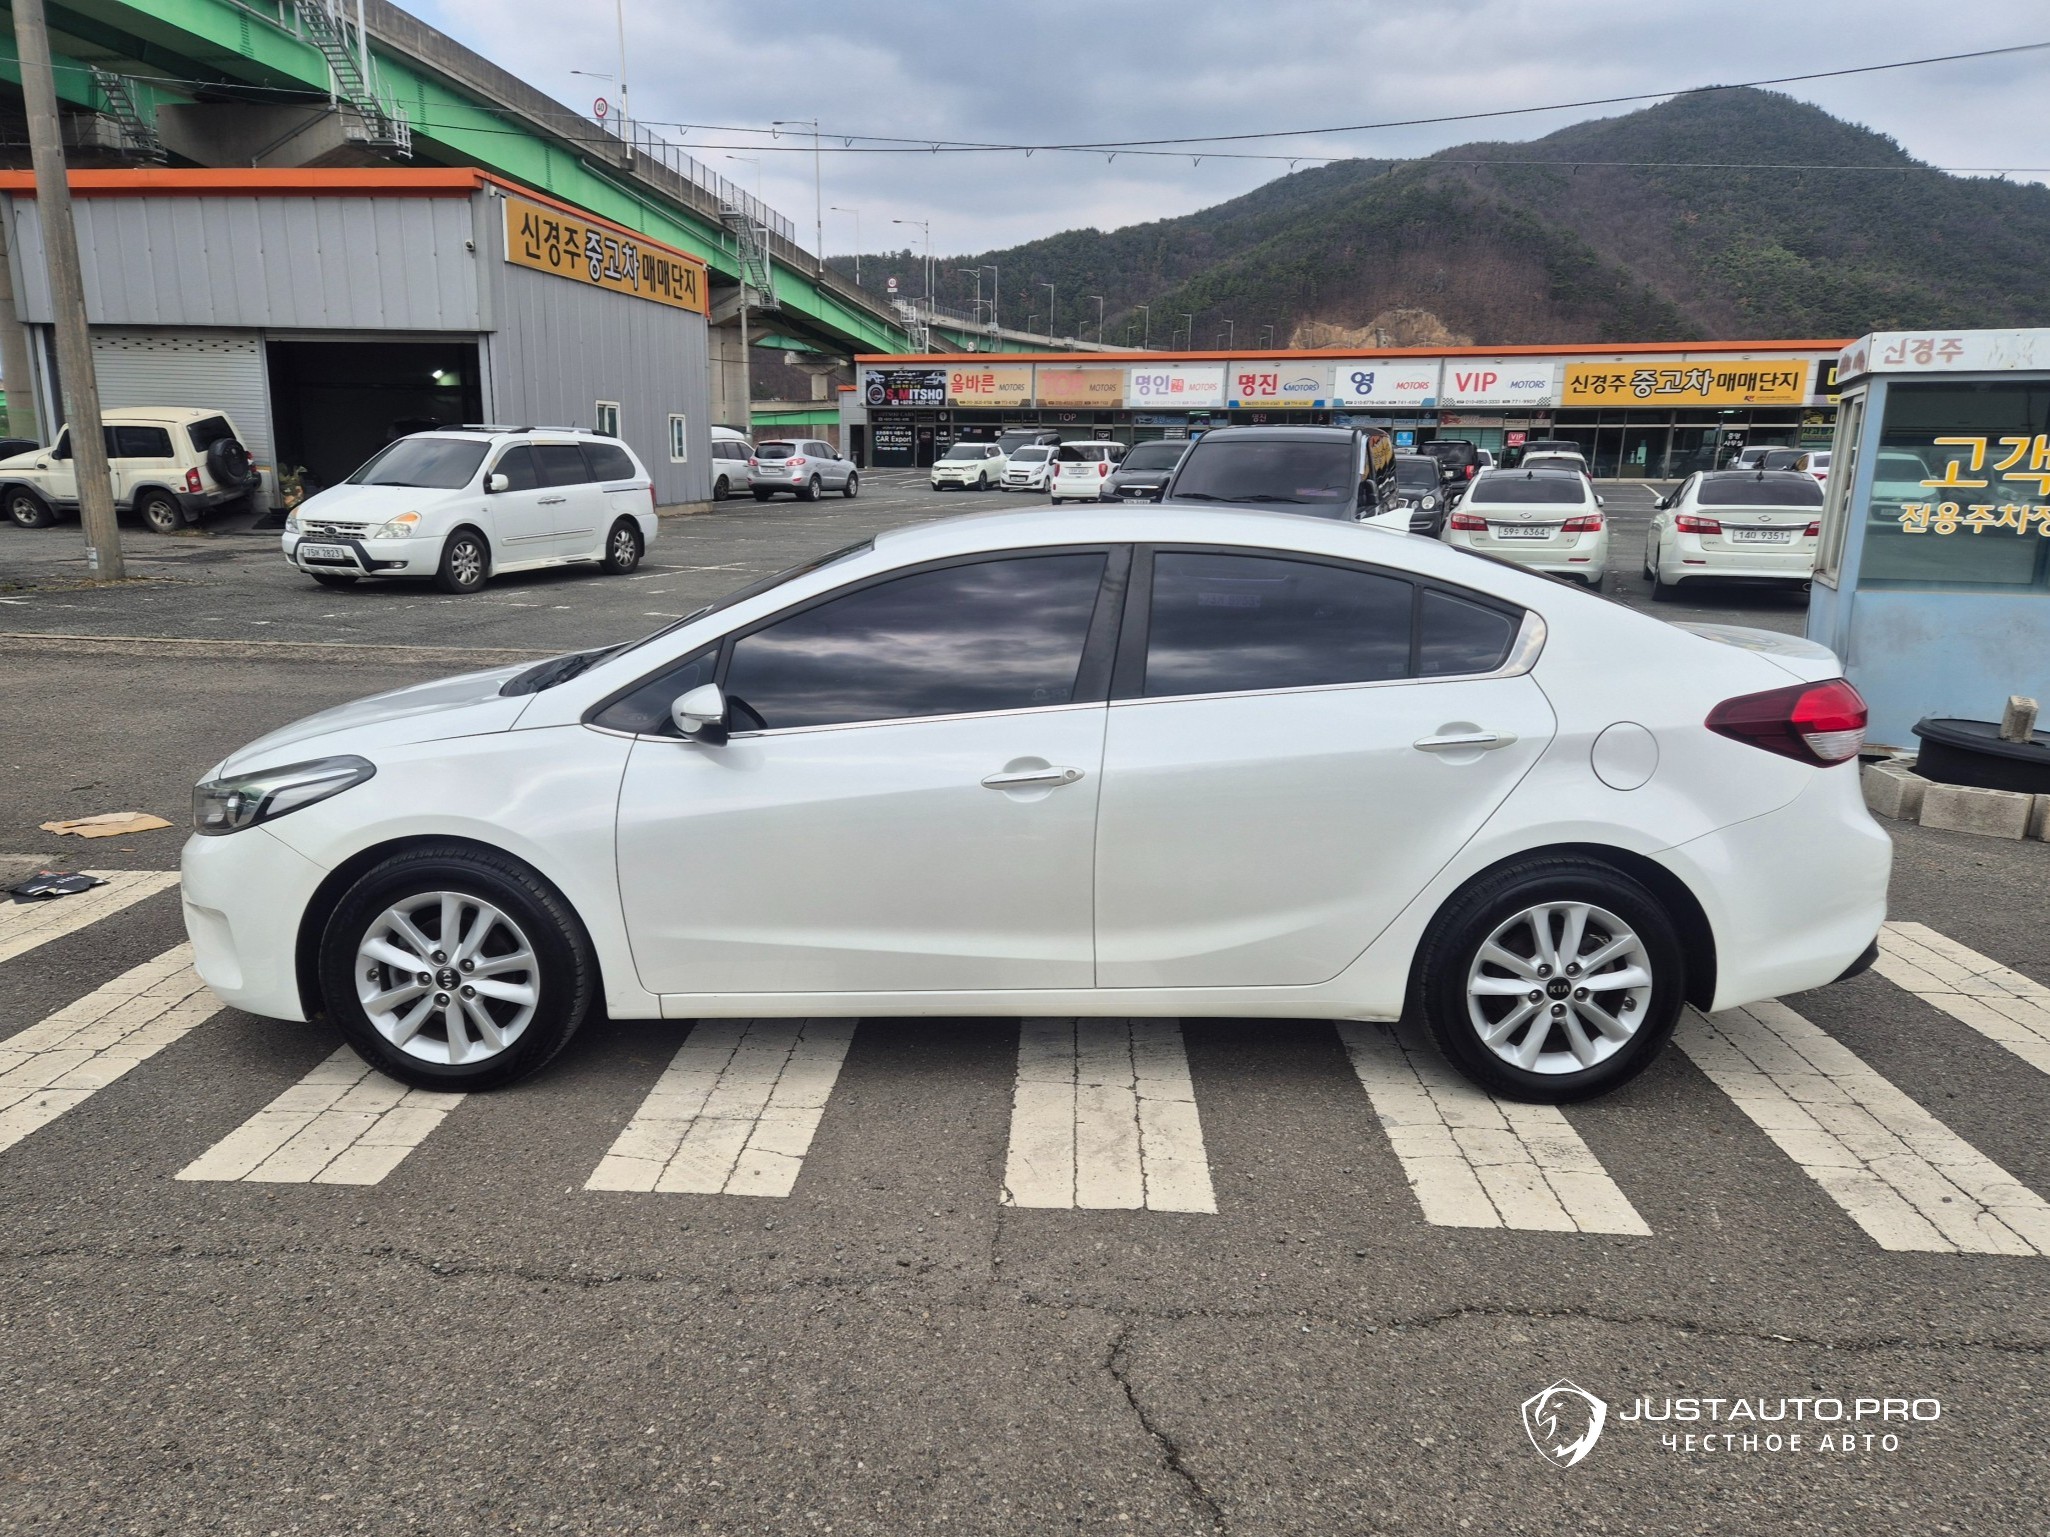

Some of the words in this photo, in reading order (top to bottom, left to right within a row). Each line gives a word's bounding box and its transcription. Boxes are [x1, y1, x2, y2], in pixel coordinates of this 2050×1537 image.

[597, 102, 605, 112] 40
[521, 212, 581, 269] 신경주
[585, 228, 640, 291] 중고차
[643, 253, 696, 304] 매매단지
[1884, 337, 1965, 365] 신경주
[950, 373, 996, 393] 올바른
[998, 383, 1025, 391] MOTORS
[1089, 383, 1117, 392] MOTORS
[1135, 374, 1170, 396] 명인
[1188, 382, 1218, 391] MOTORS
[1238, 373, 1278, 397] 명진
[1288, 384, 1317, 392] MOTORS
[1350, 371, 1375, 395] 영
[1396, 381, 1430, 390] MOTORS
[1455, 372, 1498, 392] VIP
[1510, 380, 1546, 389] MOTORS
[1570, 374, 1627, 394] 신경주
[1629, 368, 1714, 398] 중고차
[1716, 371, 1799, 391] 매매단지
[899, 389, 943, 400] MITSHO
[1058, 413, 1077, 421] TOP
[1252, 413, 1267, 422] 명진
[891, 435, 912, 443] Export
[1523, 525, 1545, 536] 6364
[1761, 531, 1785, 540] 9351
[322, 548, 340, 557] 2823
[442, 970, 453, 989] KIA
[1549, 985, 1570, 993] KIA
